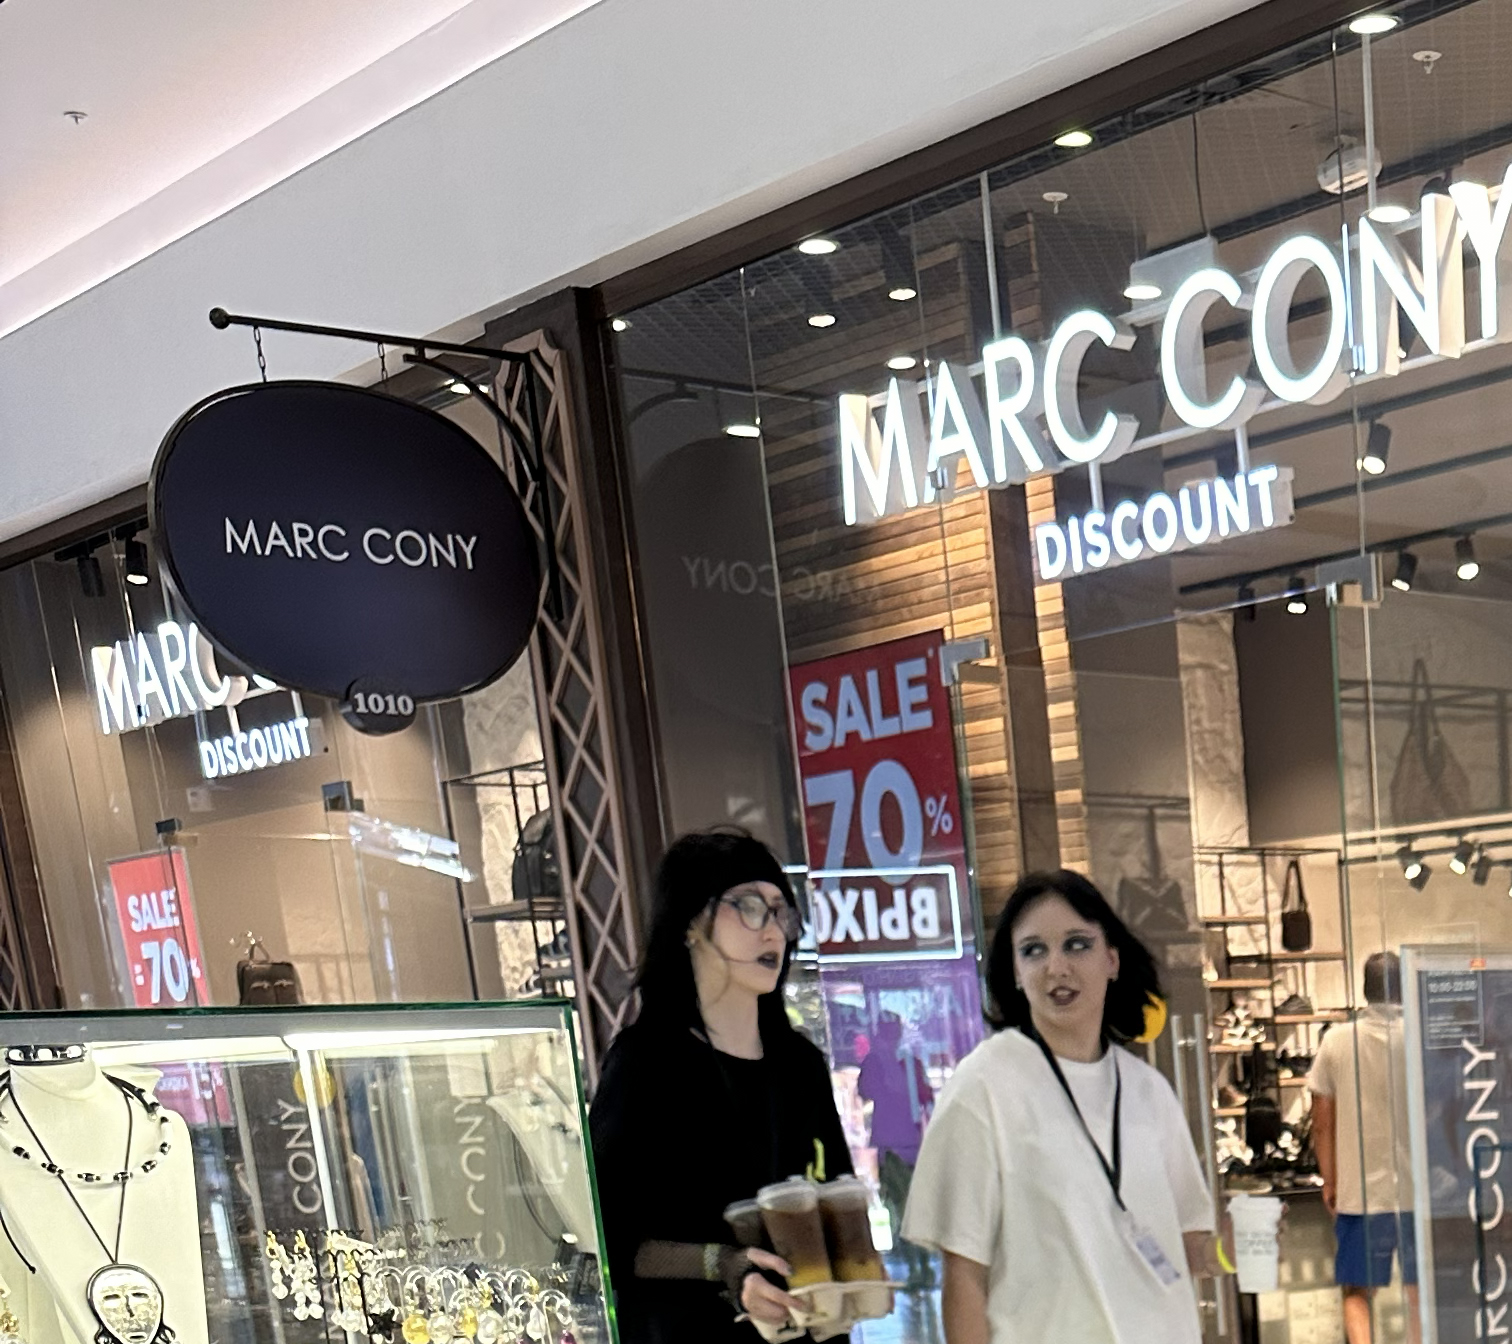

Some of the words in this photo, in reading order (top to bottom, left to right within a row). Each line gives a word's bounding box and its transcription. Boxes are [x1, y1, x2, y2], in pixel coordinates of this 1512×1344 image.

[838, 310, 1130, 526] MARC
[224, 516, 349, 563] MARC
[361, 527, 478, 571] CONY
[1034, 465, 1285, 581] DISCOUNT
[92, 618, 222, 735] MARC
[353, 690, 414, 718] 1010
[801, 656, 934, 753] SALE
[200, 716, 312, 779] DISCOUNT
[127, 888, 180, 932] SALE
[277, 1098, 323, 1215] CONY
[1462, 1039, 1504, 1231] CONY
